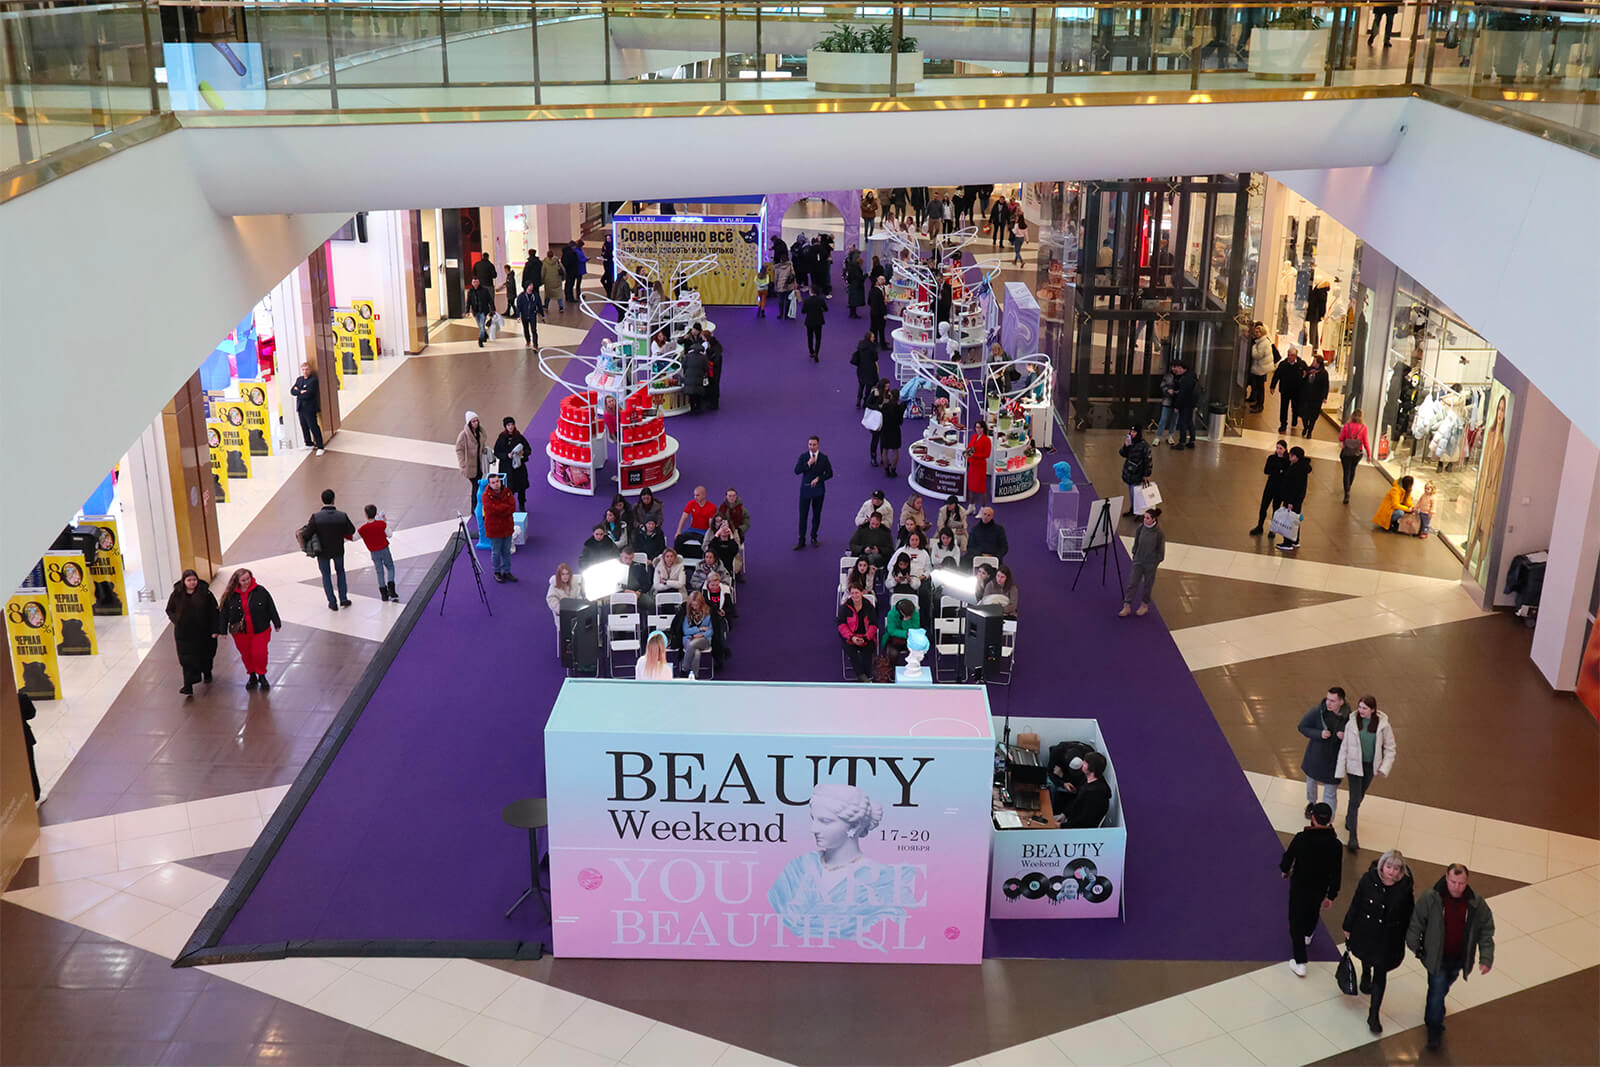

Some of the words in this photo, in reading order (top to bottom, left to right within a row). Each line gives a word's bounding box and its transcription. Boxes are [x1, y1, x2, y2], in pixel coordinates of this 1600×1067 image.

[621, 228, 706, 244] Совершенно
[709, 229, 733, 243] всё
[54, 593, 79, 603] ЧЕРНАЯ
[55, 603, 84, 613] ПЯТНИЦА
[15, 635, 41, 645] ЧЕРНАЯ
[16, 646, 48, 656] ПЯТНИЦА
[605, 751, 935, 807] BEAUTY
[607, 809, 787, 843] Weekend
[880, 829, 930, 842] 17-20
[1022, 842, 1104, 858] BEAUTY
[1021, 859, 1060, 867] Weekend
[608, 857, 759, 905] YOU
[611, 910, 927, 950] BEAUTIFUL
